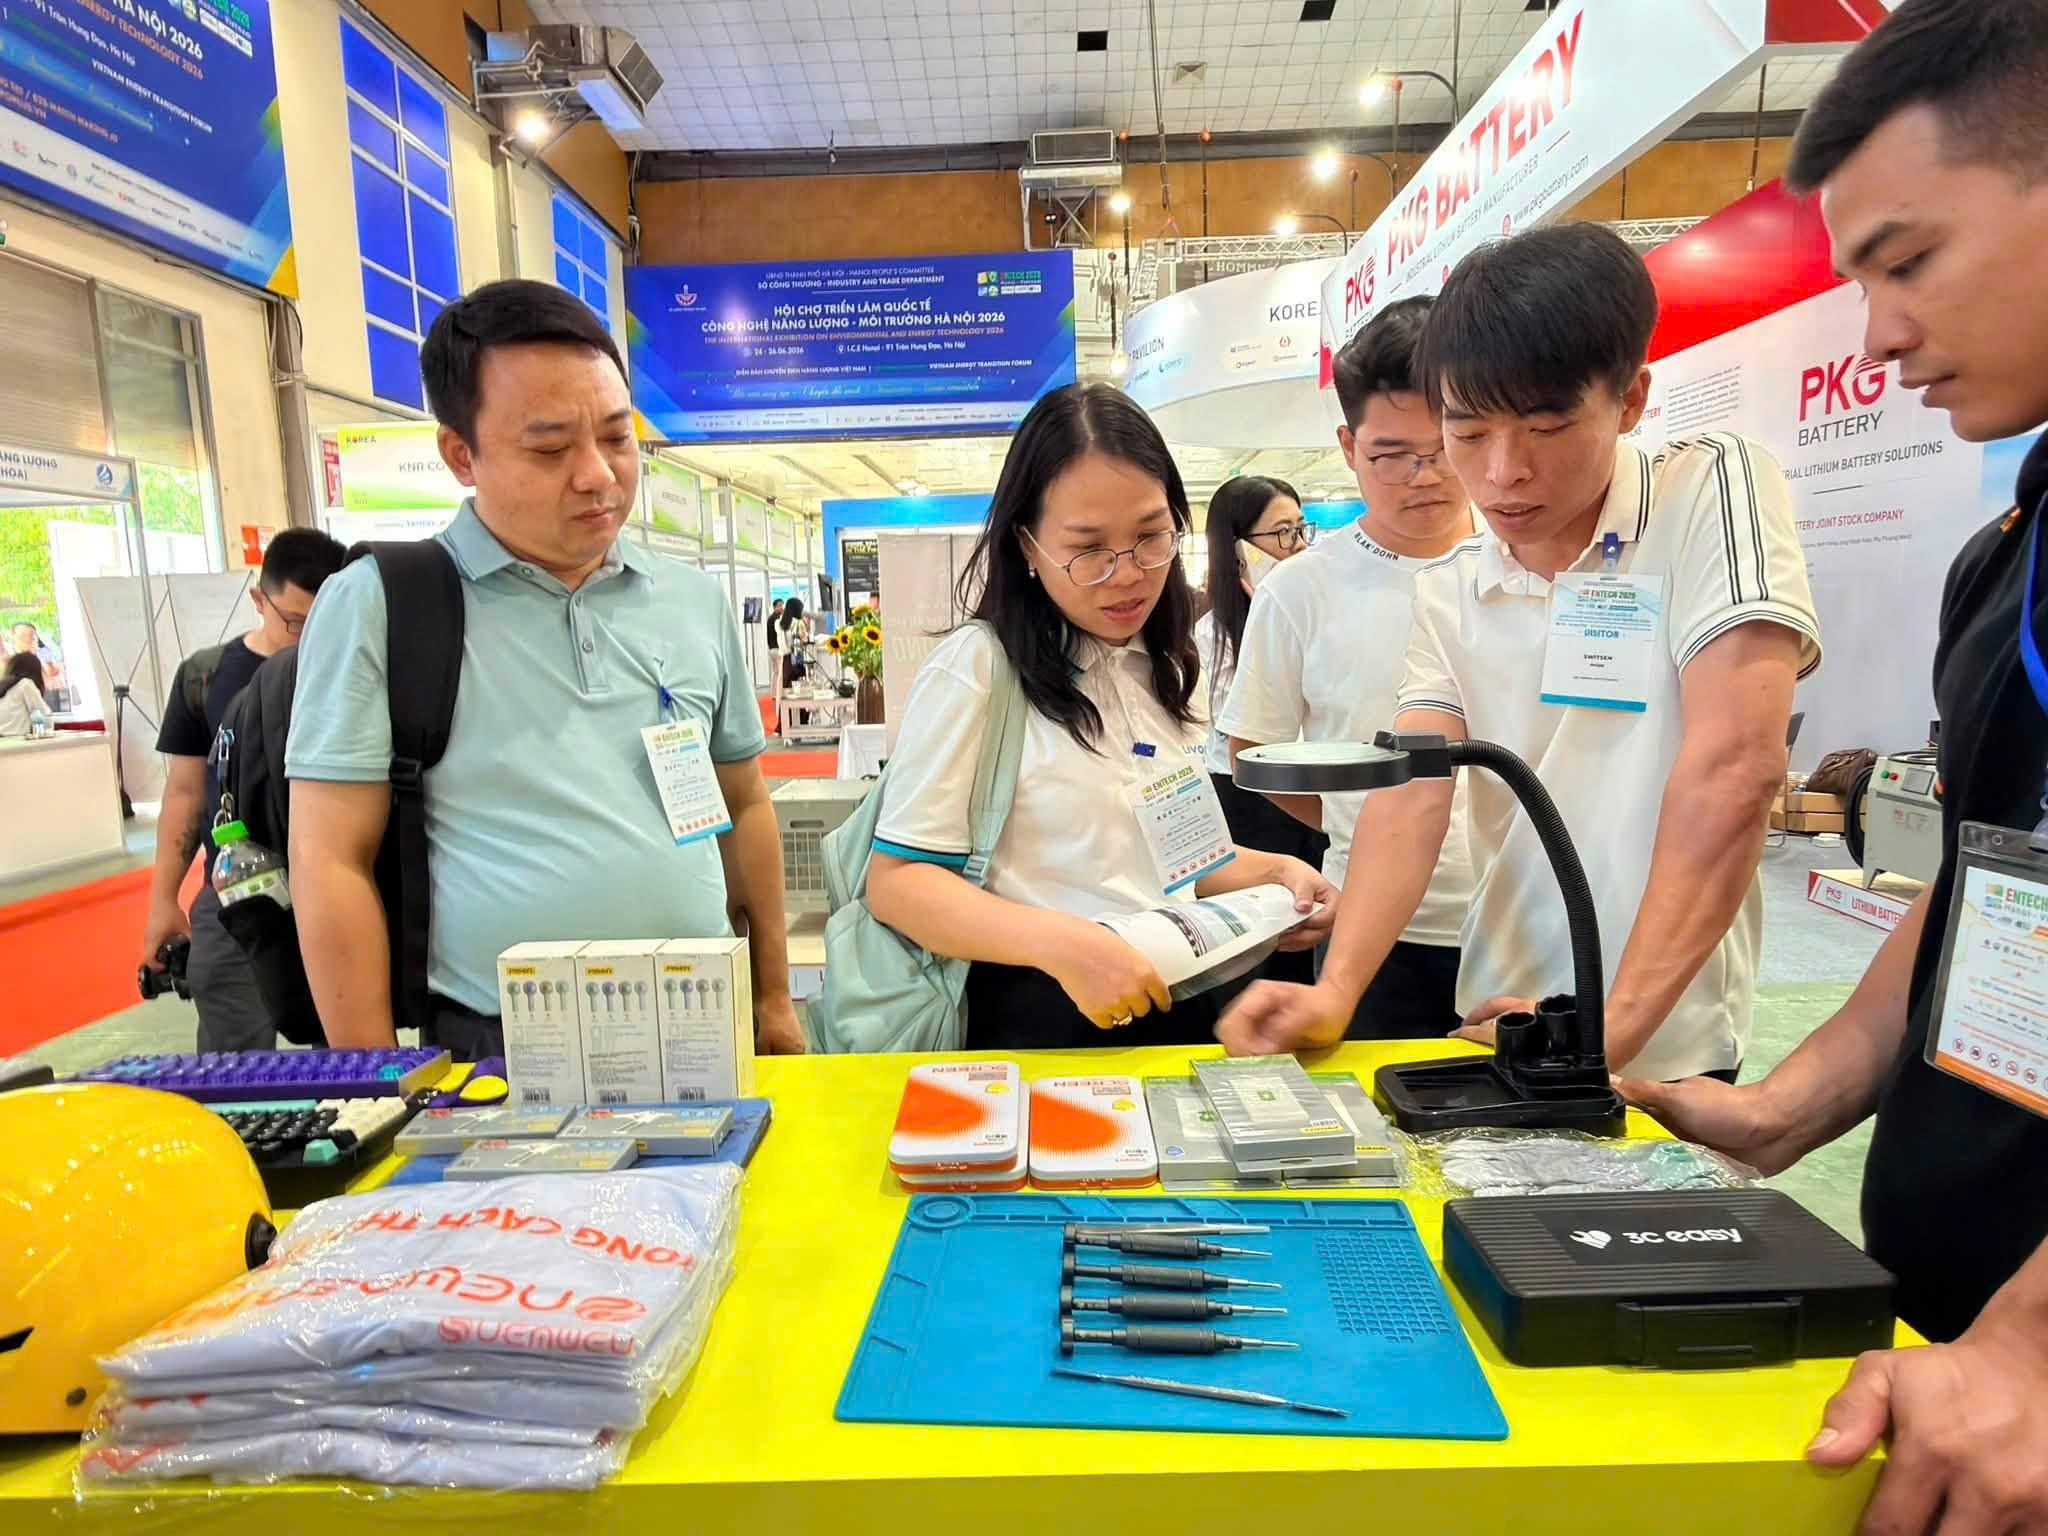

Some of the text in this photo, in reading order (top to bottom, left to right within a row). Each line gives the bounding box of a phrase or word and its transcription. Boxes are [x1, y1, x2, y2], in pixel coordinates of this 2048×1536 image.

[169, 26, 203, 60] 2026
[1387, 185, 1429, 277] PKG
[1345, 255, 1375, 323] PKG
[774, 304, 795, 318] HỘI
[798, 304, 822, 317] CHỢ
[954, 311, 975, 325] NỘI
[978, 312, 1006, 323] 2026
[1270, 301, 1320, 322] KORE
[1799, 353, 1887, 422] PKG
[1798, 411, 1883, 447] BATTERY
[1804, 460, 1839, 477] LITHIUM
[1841, 451, 1883, 471] BATTERY
[1885, 440, 1943, 463] SOLUTIONS
[1816, 517, 1836, 529] JOINT
[1838, 514, 1863, 527] STOCK
[1864, 509, 1904, 524] COMPANY
[1622, 1228, 1743, 1244] 3C easy
